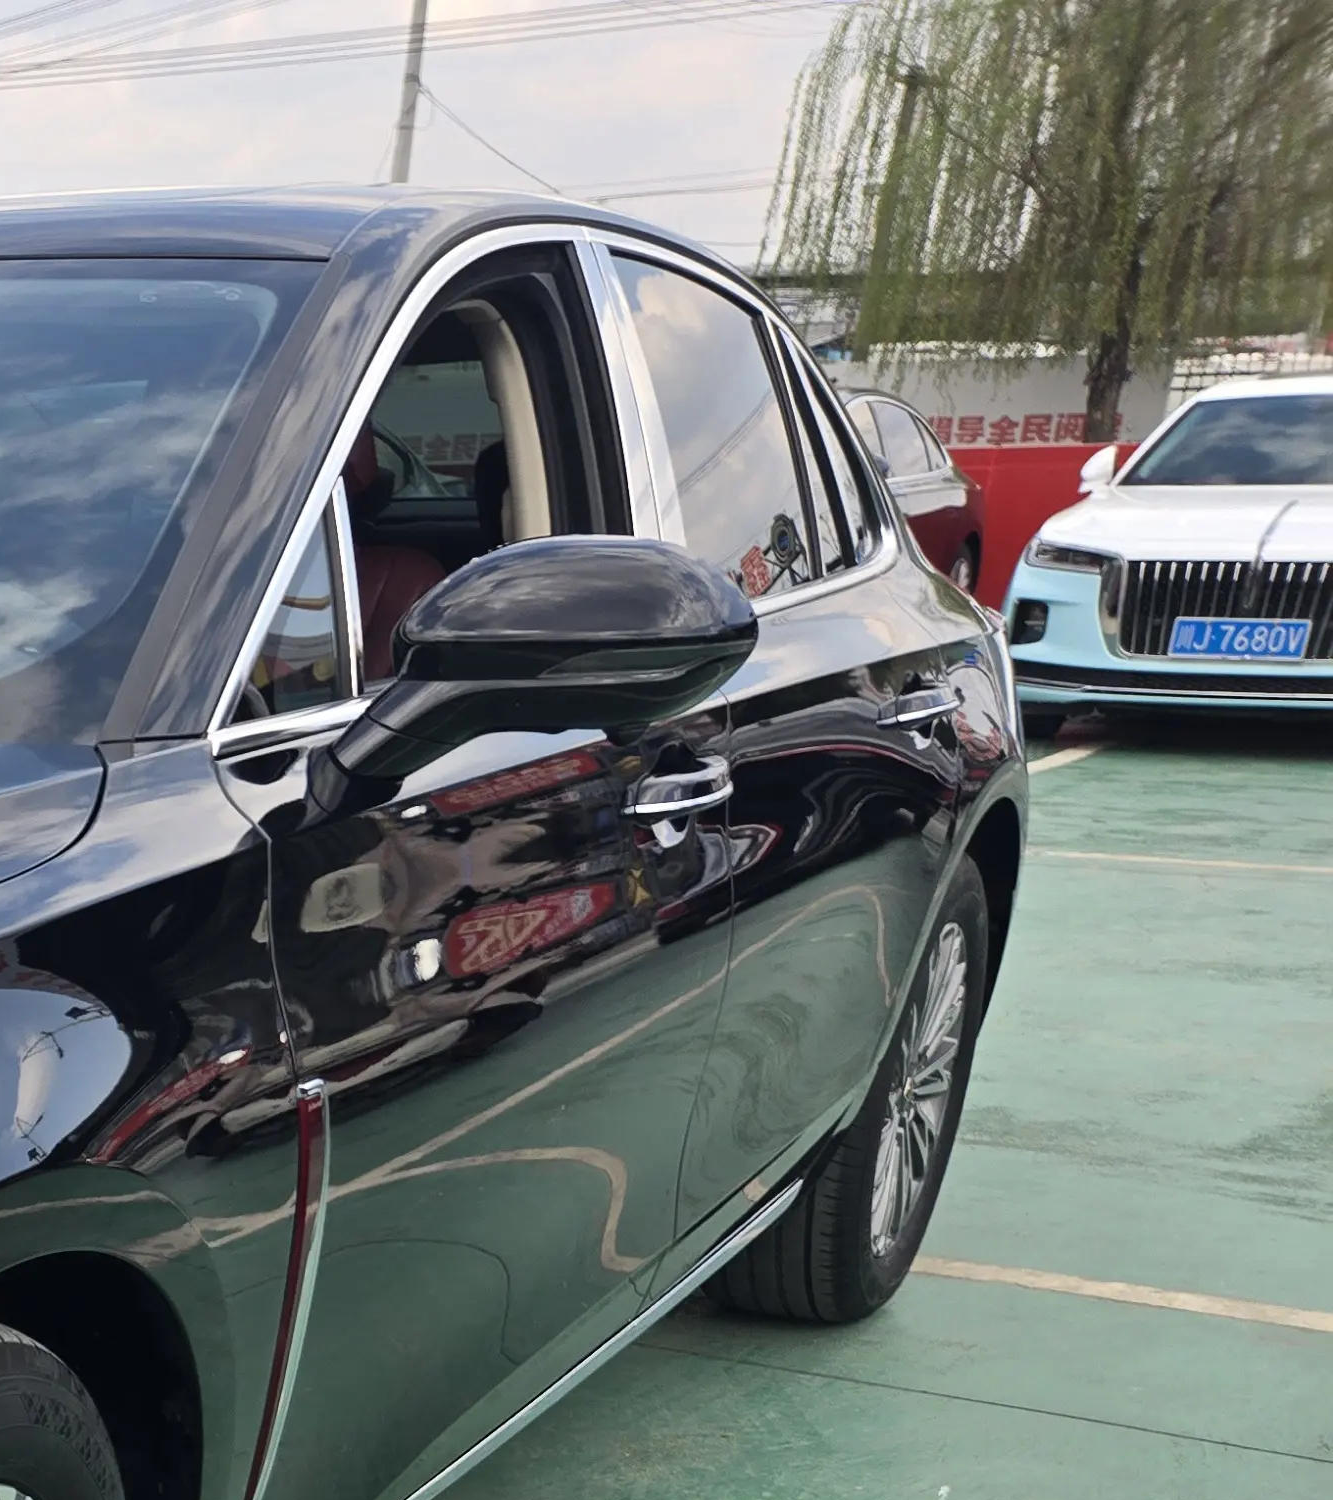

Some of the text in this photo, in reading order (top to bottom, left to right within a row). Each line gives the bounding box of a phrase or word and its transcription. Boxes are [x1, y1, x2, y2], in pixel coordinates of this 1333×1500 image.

[929, 412, 1122, 444] 倡导全民阅
